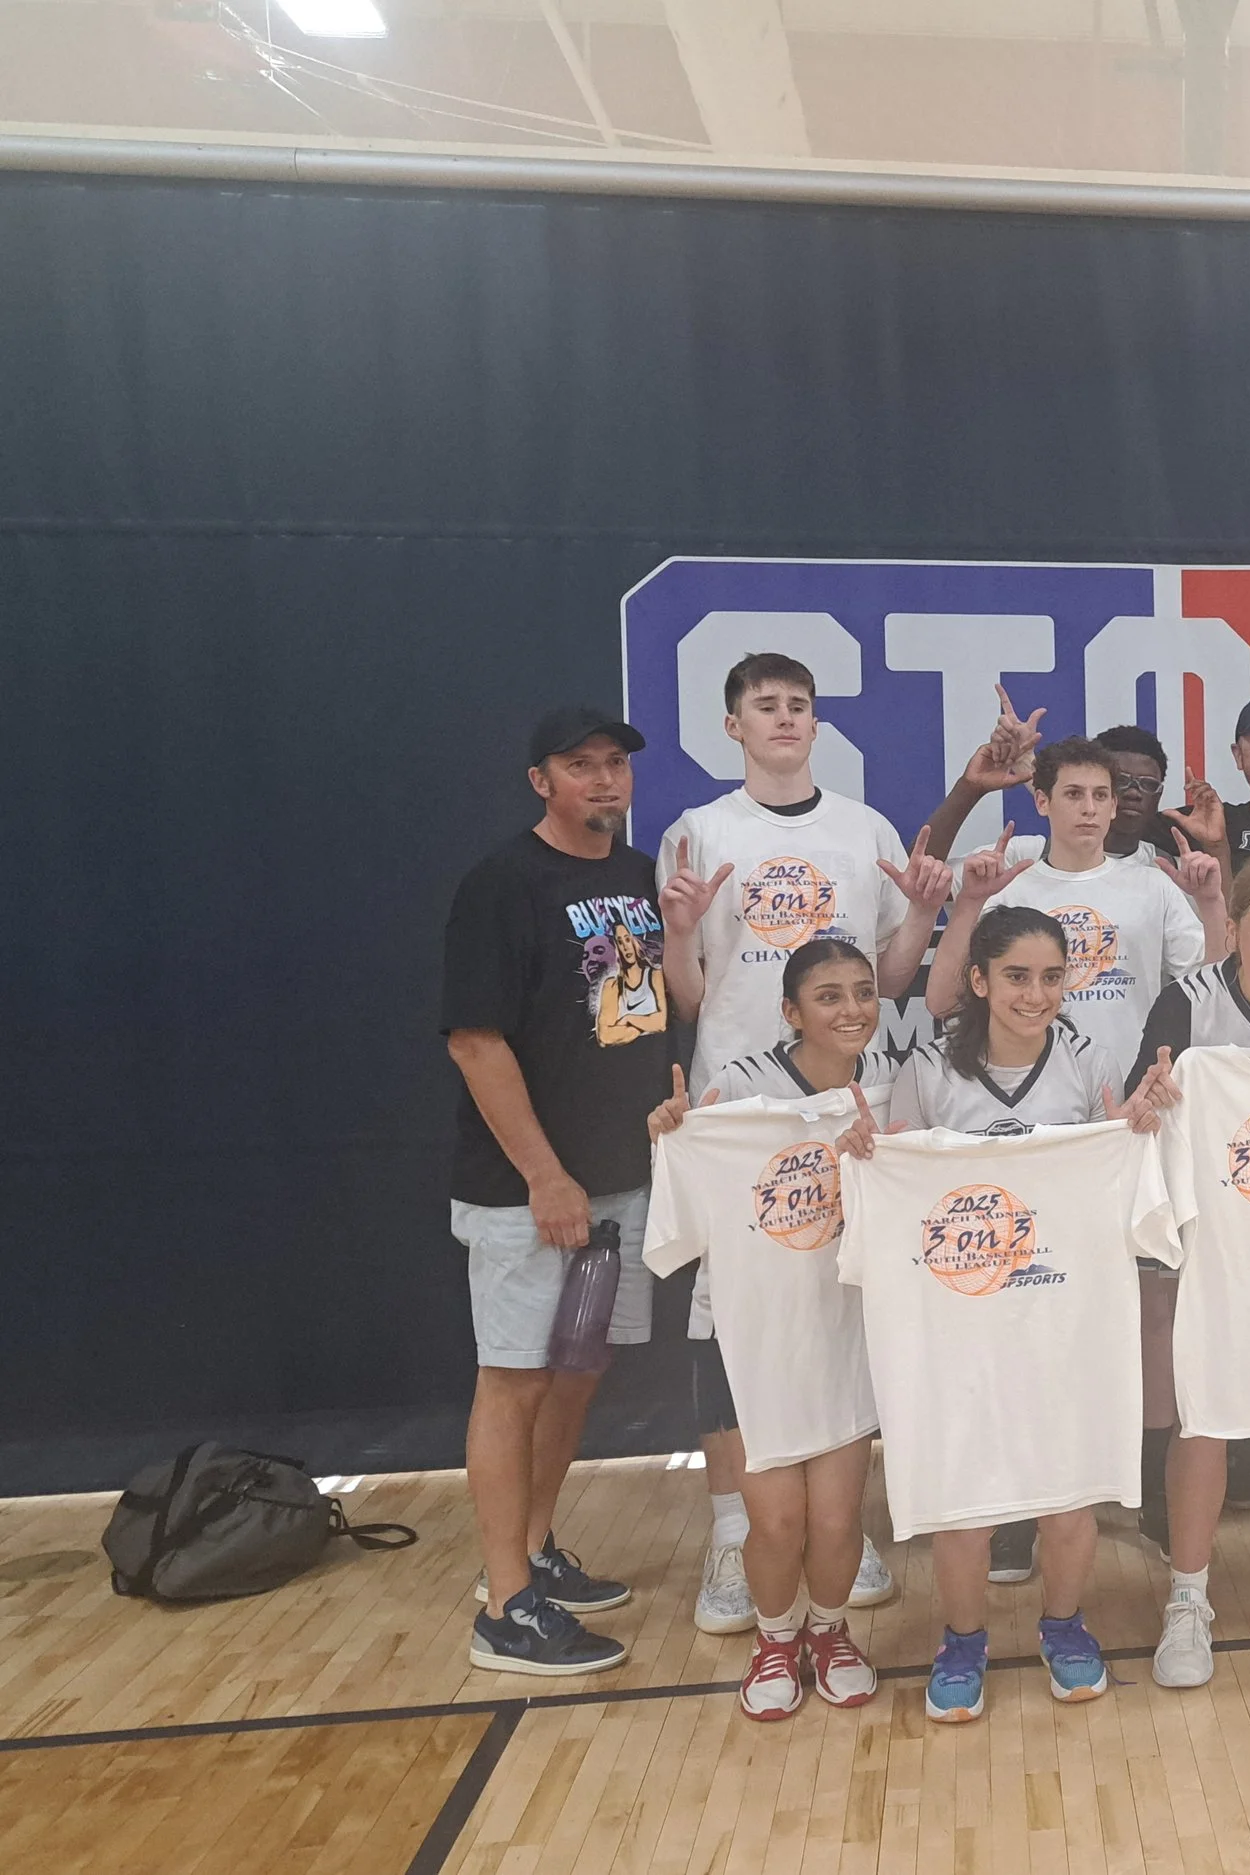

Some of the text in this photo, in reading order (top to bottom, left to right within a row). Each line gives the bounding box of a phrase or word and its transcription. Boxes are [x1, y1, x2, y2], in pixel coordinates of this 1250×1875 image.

[764, 866, 808, 882] 2025
[744, 887, 832, 914] 3 on 3
[734, 911, 848, 921] YOUTH BASKETBALL
[1097, 930, 1115, 955] 3
[776, 1149, 824, 1176] 2025
[1231, 1147, 1250, 1178] 3
[752, 1164, 841, 1191] MARCH MADN
[759, 1184, 827, 1221] 3 on
[947, 1194, 1001, 1215] 2025
[748, 1214, 794, 1231] YOUTH
[789, 1210, 838, 1228] LEAGUE
[921, 1210, 1037, 1226] MARCH MADNESS
[925, 1218, 1032, 1257] 3 on 3
[912, 1247, 1053, 1266] YOUTH BASKETBALL
[955, 1259, 1011, 1270] LEAGUE
